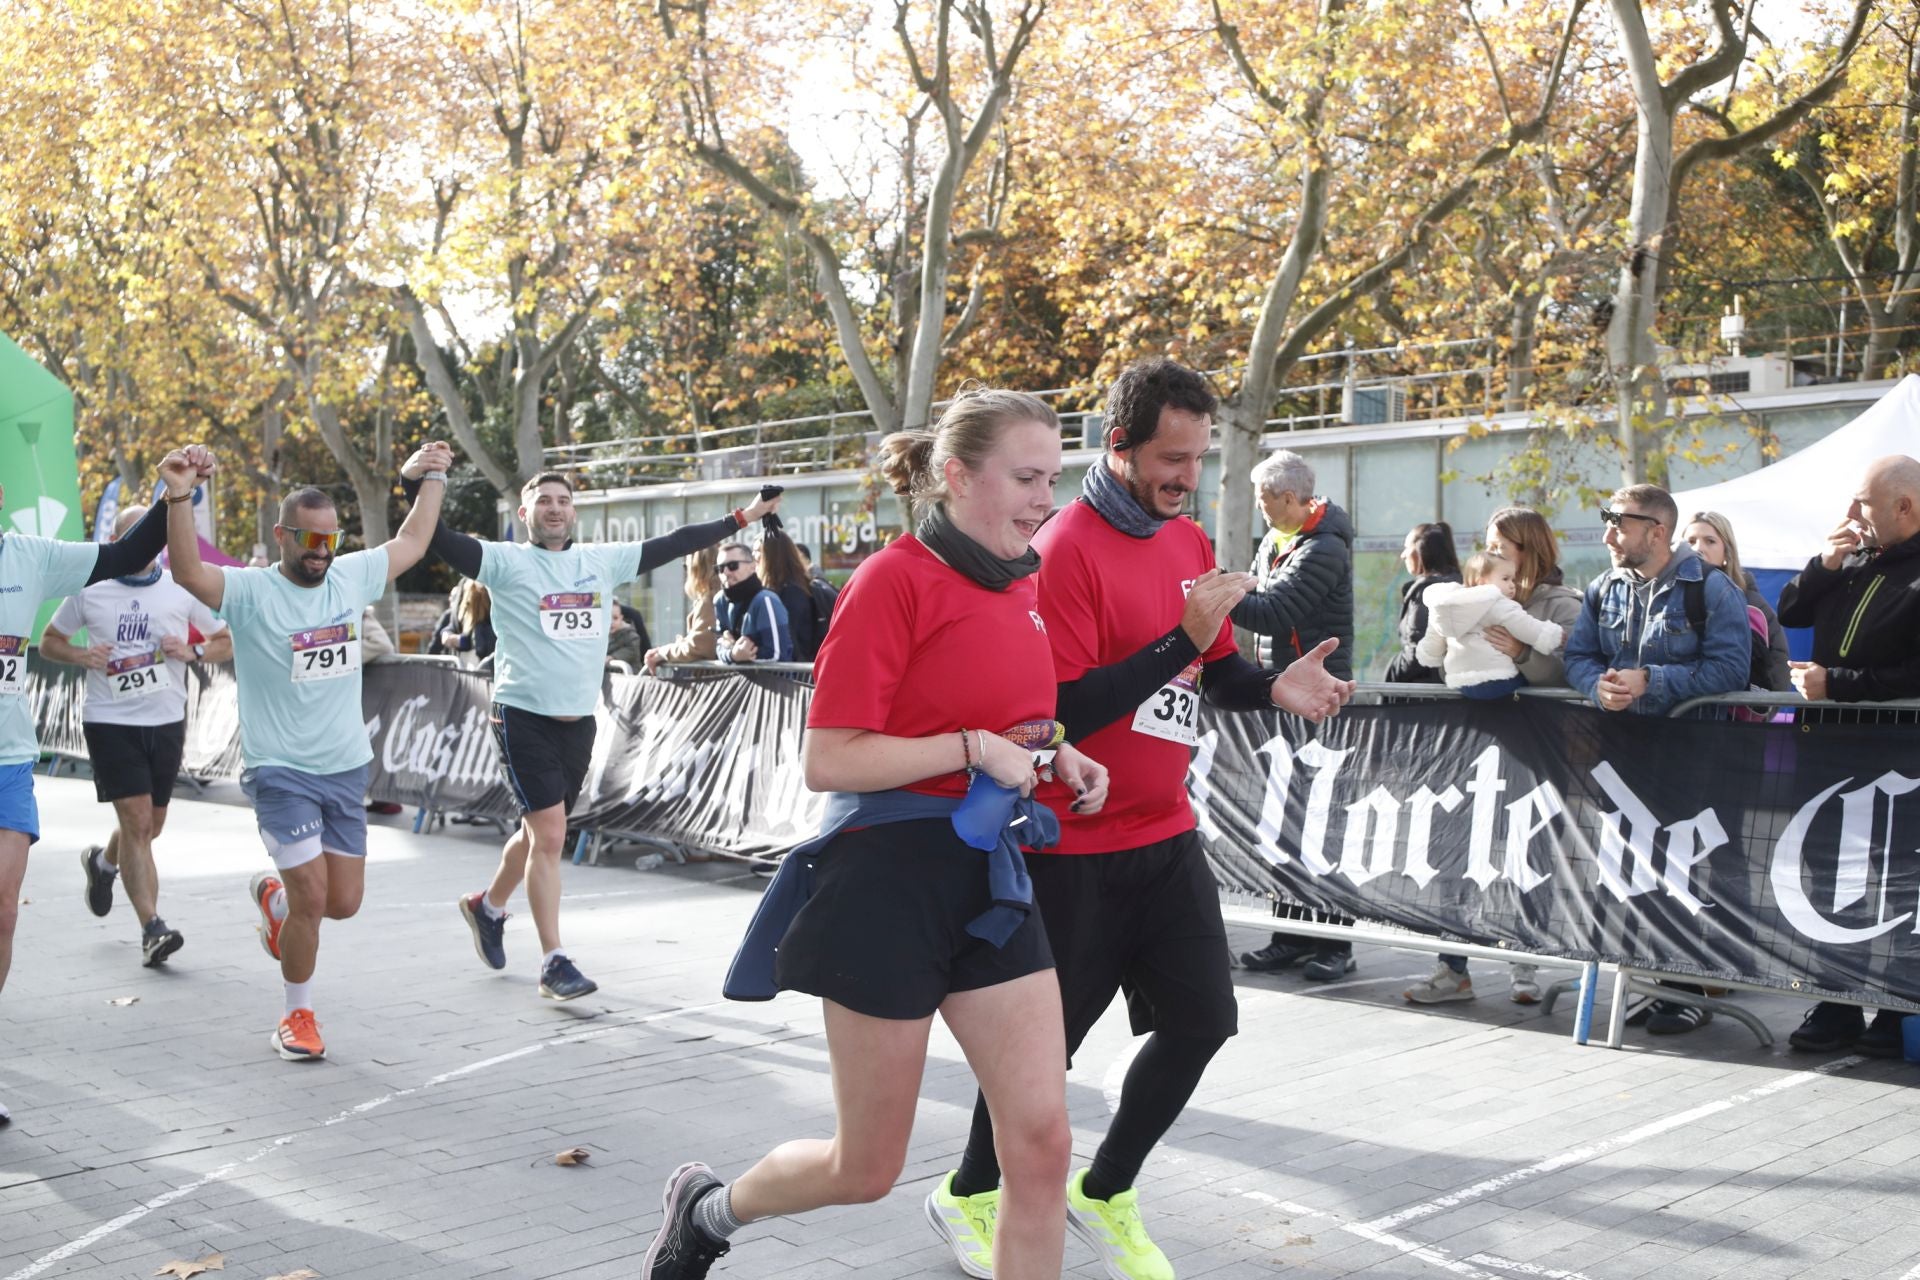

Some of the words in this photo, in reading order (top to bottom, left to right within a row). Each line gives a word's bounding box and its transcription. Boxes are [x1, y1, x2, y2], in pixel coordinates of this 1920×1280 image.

[787, 502, 878, 553] amiga
[119, 613, 150, 623] PUCELA
[549, 611, 593, 631] 793
[117, 623, 149, 642] RUN
[303, 645, 347, 671] 791
[117, 667, 158, 692] 291
[382, 694, 503, 787] Castil
[1252, 734, 1563, 895] Norte
[1590, 759, 1731, 917] de
[1769, 769, 1920, 945] C
